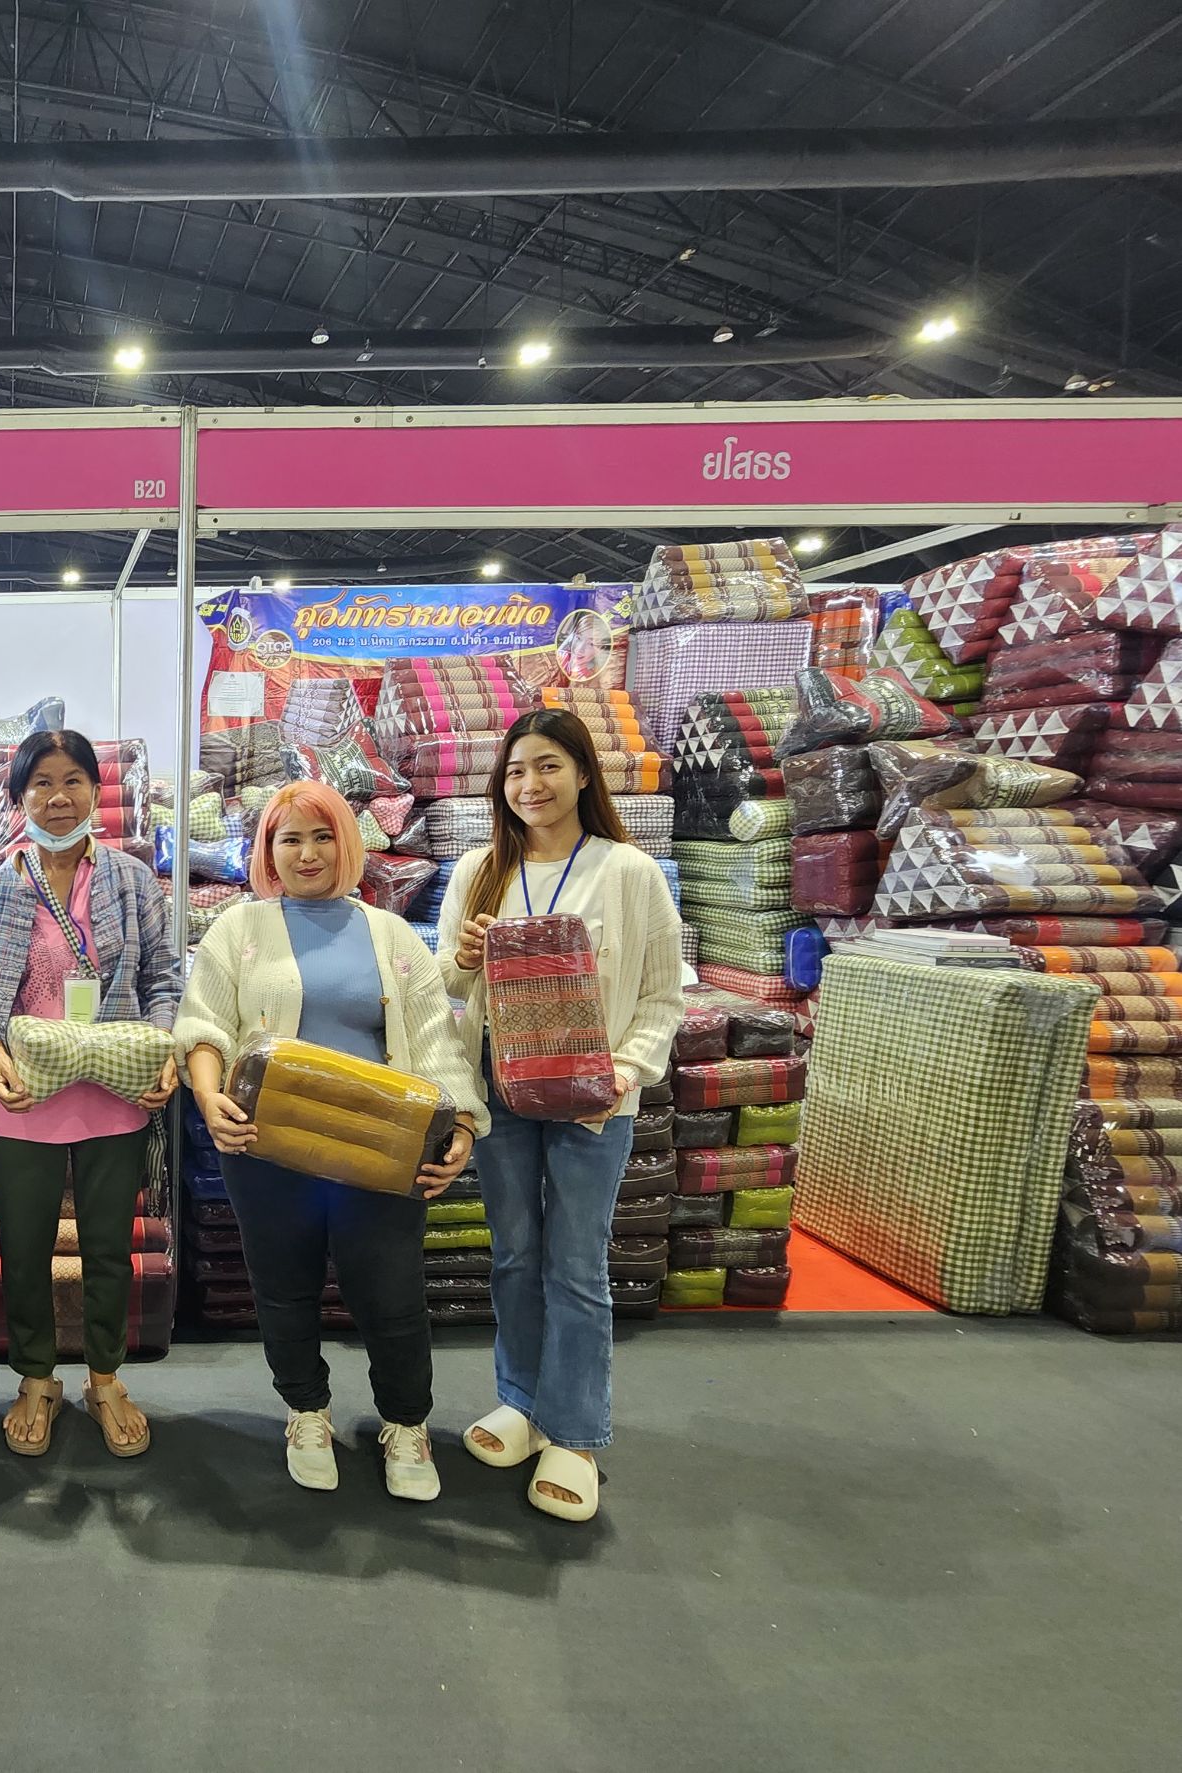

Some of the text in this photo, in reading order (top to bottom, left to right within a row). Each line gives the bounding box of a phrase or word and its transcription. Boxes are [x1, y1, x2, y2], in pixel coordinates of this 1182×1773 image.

[702, 436, 792, 480] ยโสธร
[134, 479, 166, 499] B20
[256, 641, 292, 653] OTOP
[312, 637, 332, 647] 206
[337, 637, 355, 647] ม.2
